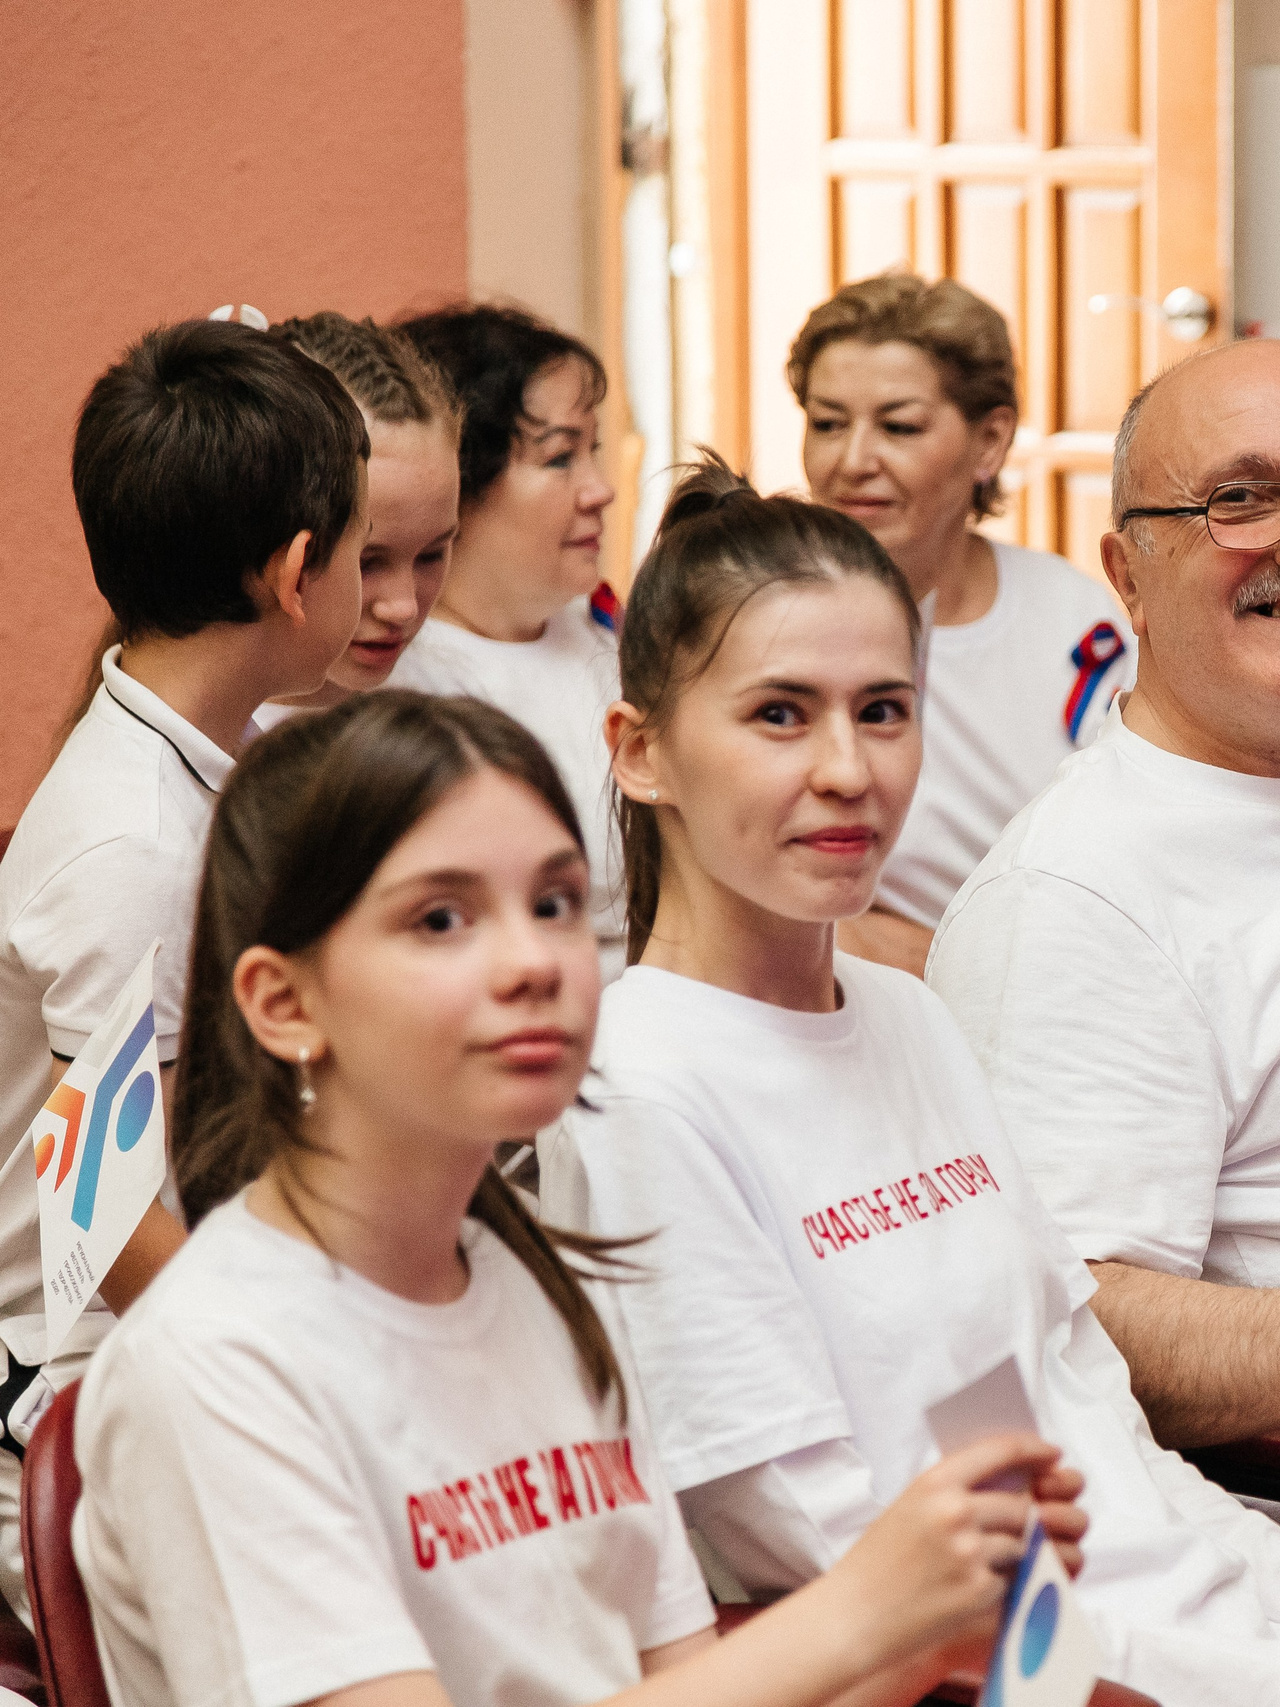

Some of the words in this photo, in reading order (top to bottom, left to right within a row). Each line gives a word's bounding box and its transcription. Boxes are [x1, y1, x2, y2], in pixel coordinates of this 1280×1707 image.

[802, 1188, 902, 1260] СЧАСТЬЕ
[888, 1178, 929, 1223] НЕ
[918, 1172, 953, 1213] ЗА
